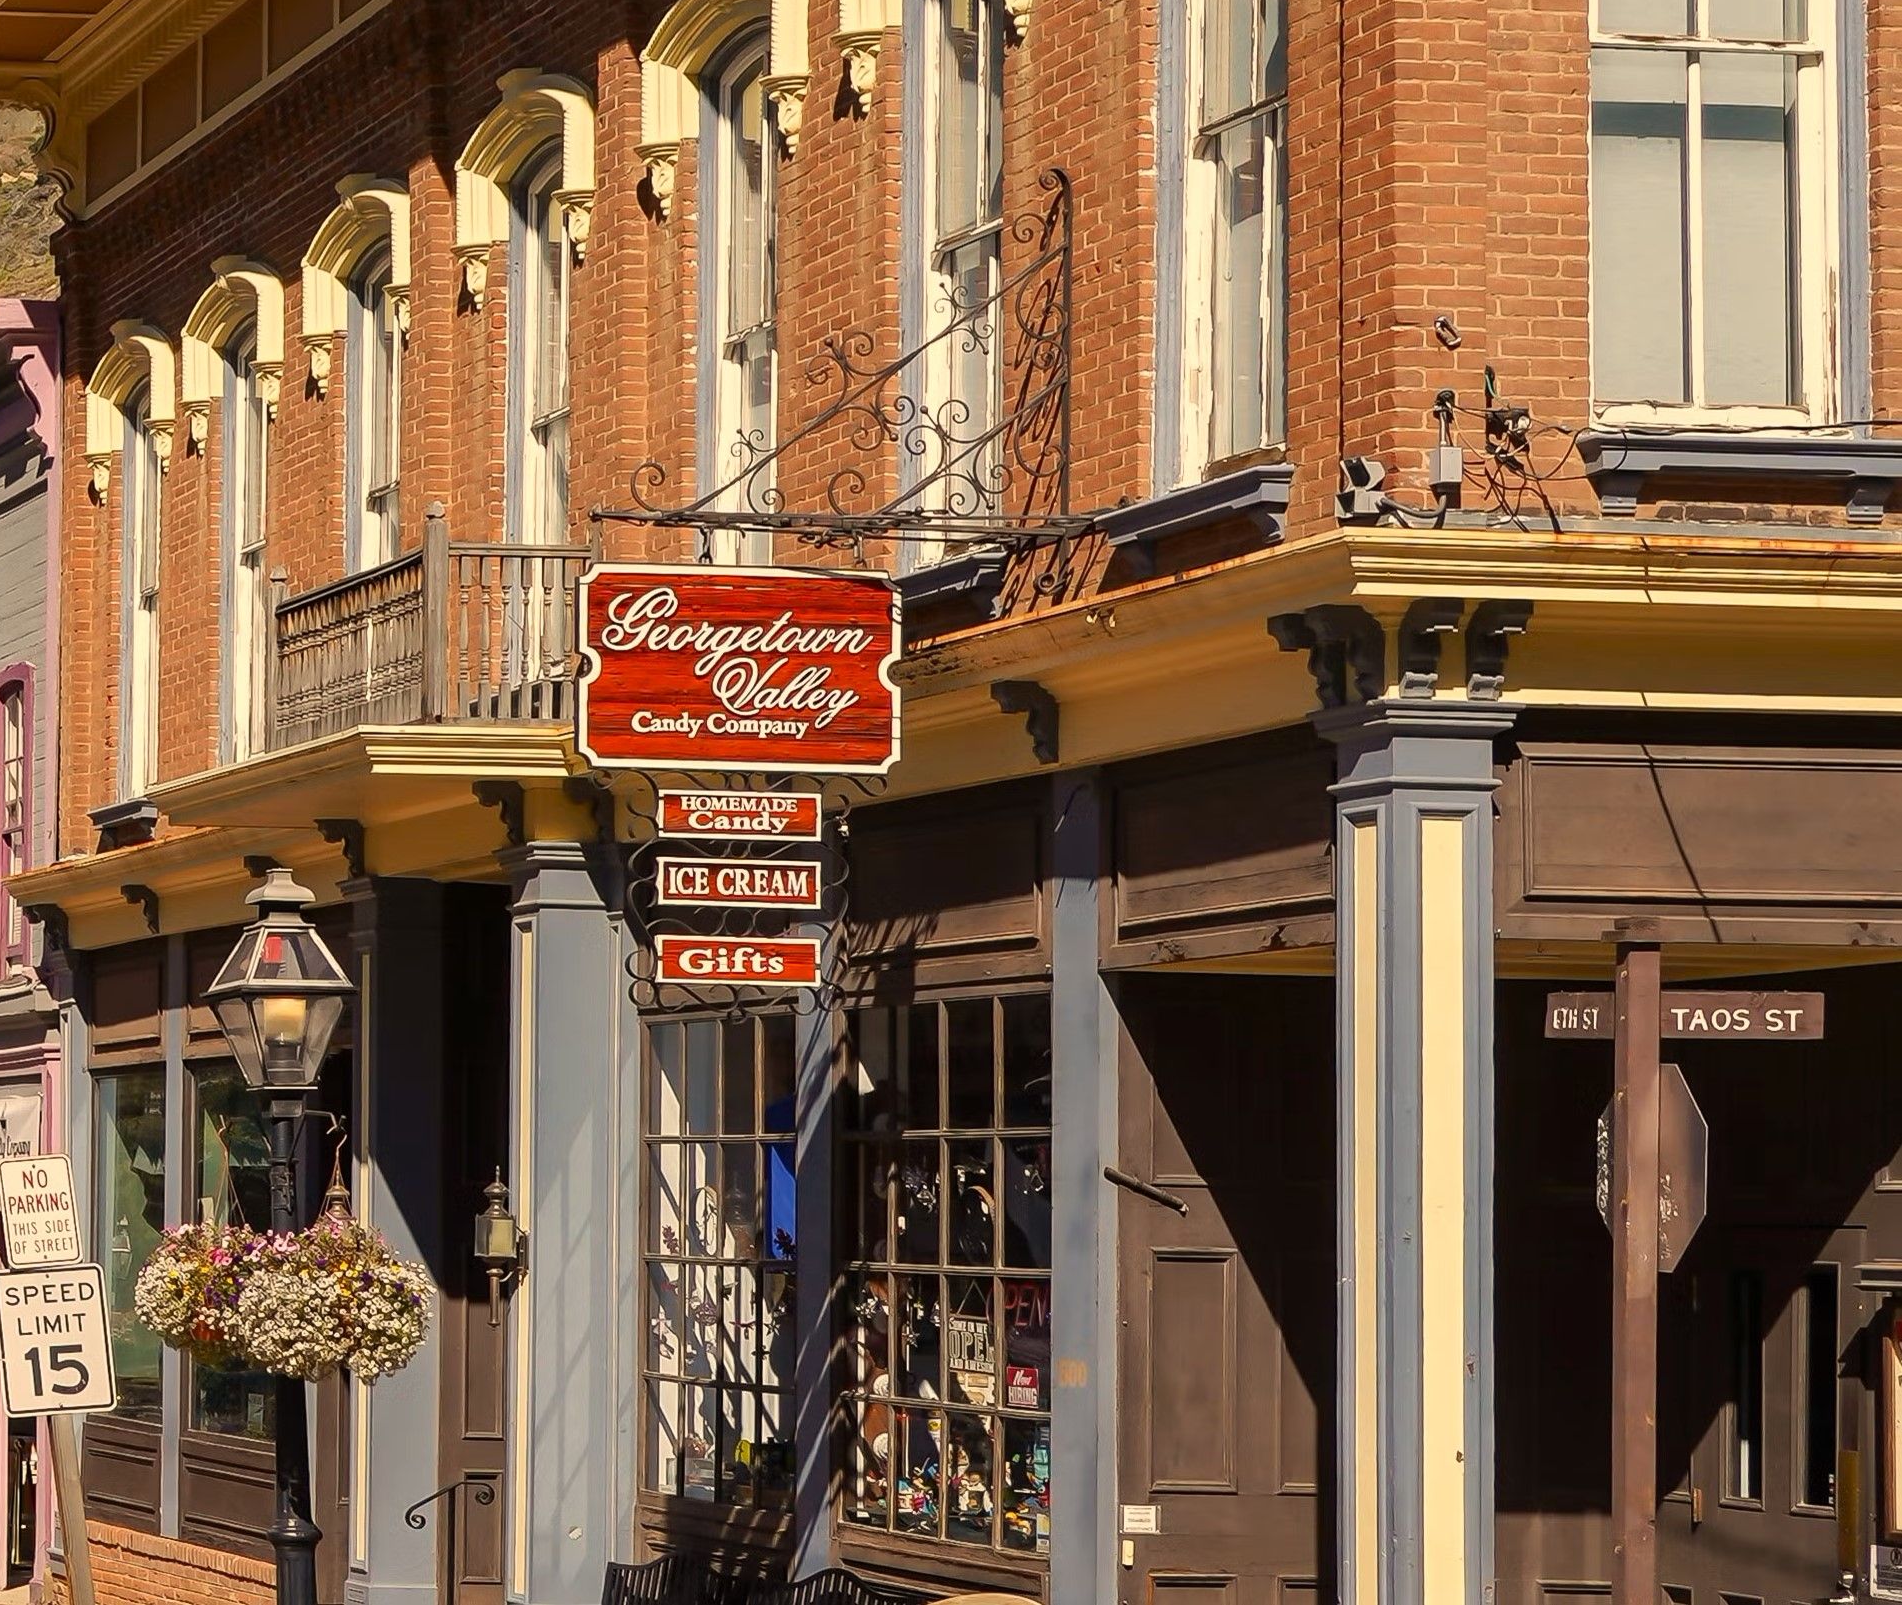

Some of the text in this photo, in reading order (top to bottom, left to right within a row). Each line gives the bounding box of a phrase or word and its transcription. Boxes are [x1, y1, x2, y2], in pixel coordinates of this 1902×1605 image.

[601, 587, 873, 676] Georgetown
[711, 657, 859, 729] Valley
[631, 711, 810, 739] Candy Company
[680, 796, 798, 813] HOMEMADE
[687, 811, 790, 834] Candy
[667, 866, 809, 898] ICE CREAM
[678, 946, 785, 974] Gifts
[1582, 1007, 1599, 1031] ST
[1670, 1007, 1804, 1032] TAOS ST
[22, 1169, 48, 1189] NO
[8, 1191, 69, 1215] PARKING
[12, 1218, 71, 1236] THIS SIDE
[14, 1236, 74, 1255] OF STREET
[5, 1282, 95, 1306] SPEED
[17, 1313, 87, 1336] LIMIT
[24, 1343, 90, 1397] 15
[1012, 1369, 1033, 1386] Now
[1008, 1385, 1038, 1406] HIRING
